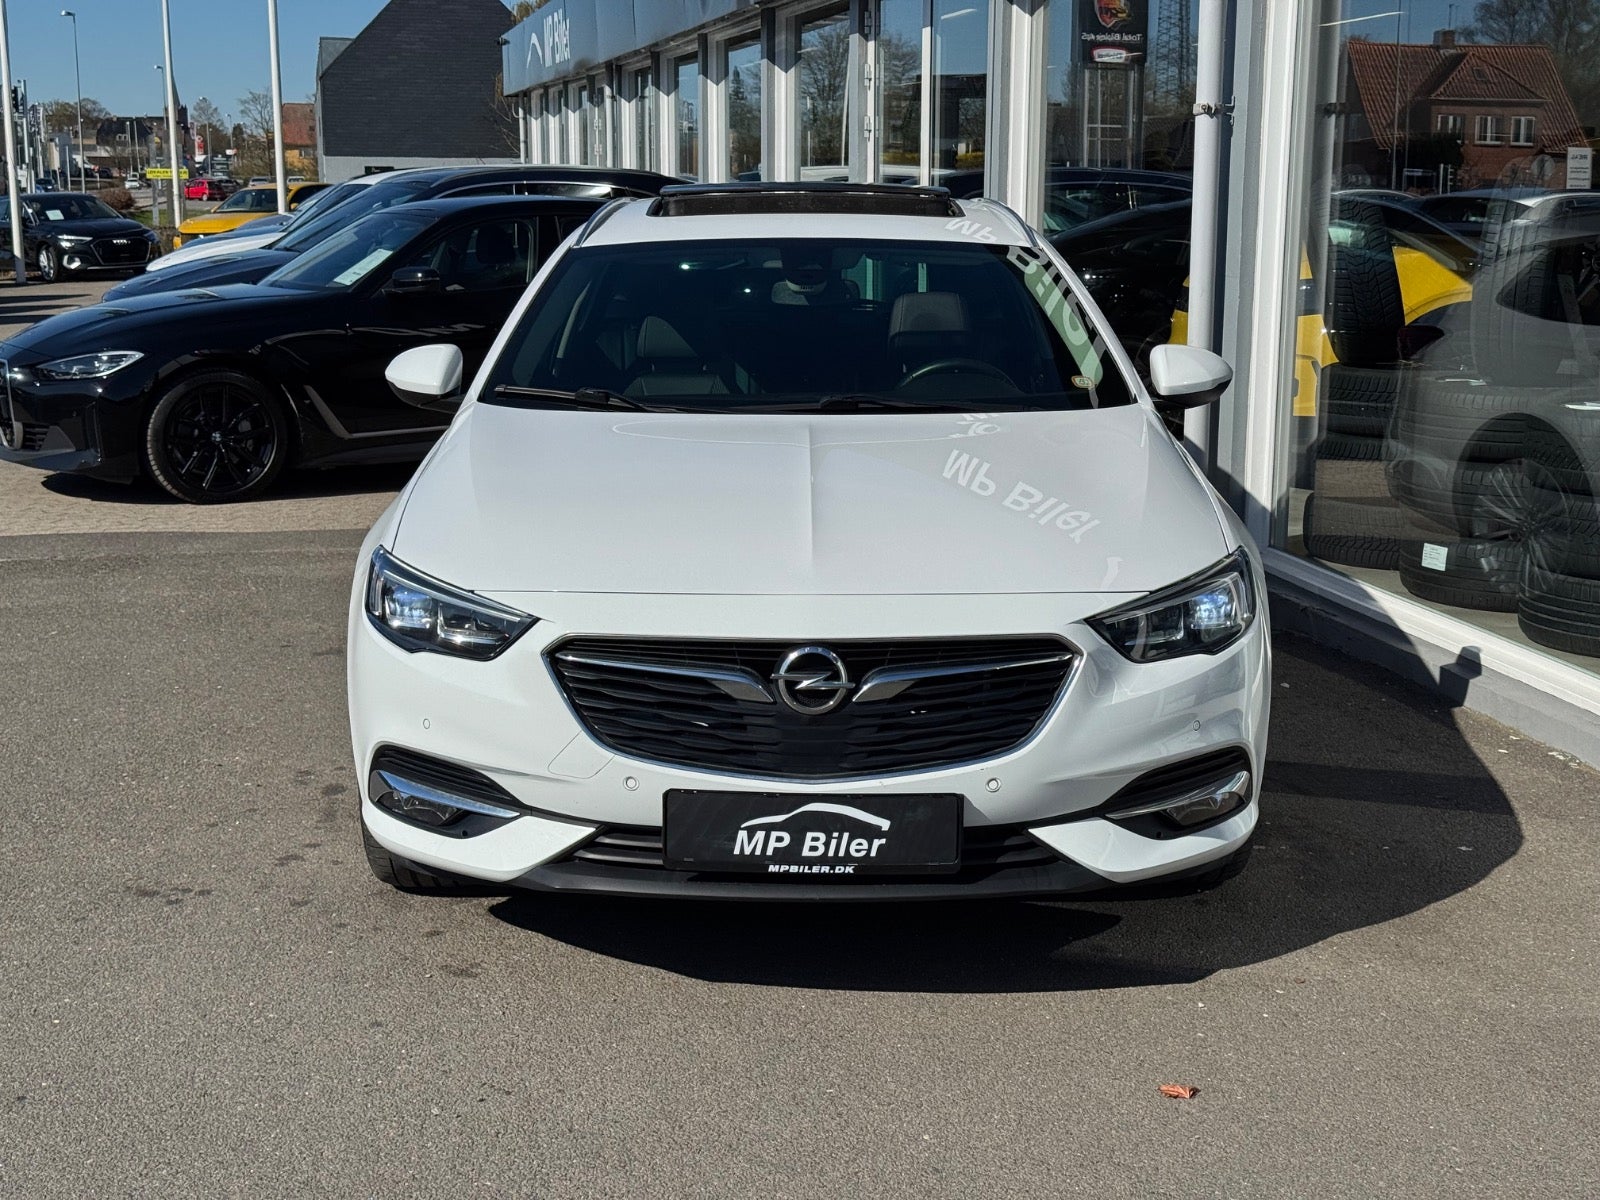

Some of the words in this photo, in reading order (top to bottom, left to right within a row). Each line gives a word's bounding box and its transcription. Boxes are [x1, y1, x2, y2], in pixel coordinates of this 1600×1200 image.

[543, 15, 553, 67] MP
[554, 8, 570, 64] Biler
[733, 830, 791, 856] MP
[802, 832, 887, 858] Biler
[768, 864, 856, 874] MPBILER.DK
